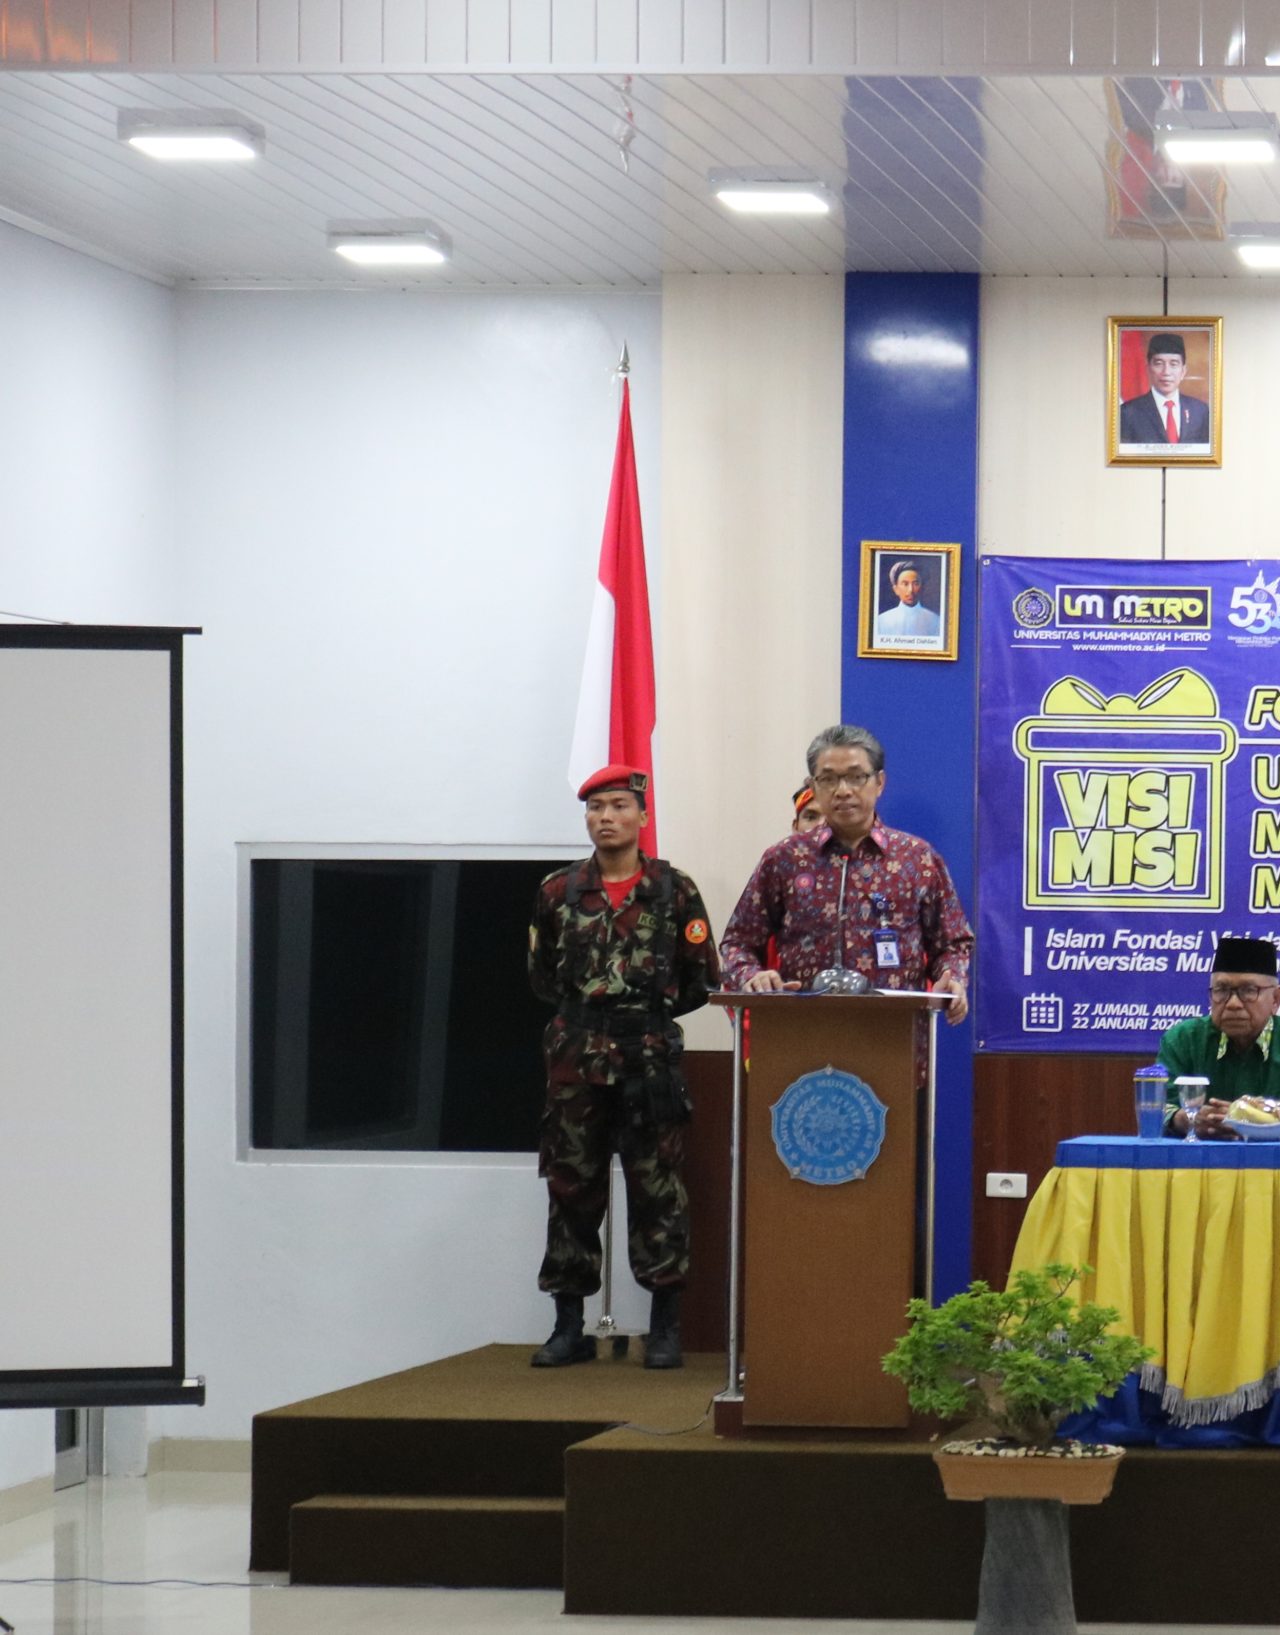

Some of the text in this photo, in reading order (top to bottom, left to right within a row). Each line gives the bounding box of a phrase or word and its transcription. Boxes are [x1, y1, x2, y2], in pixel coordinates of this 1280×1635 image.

[1113, 595, 1204, 623] METRO
[1013, 630, 1211, 642] UNIVERSITAS MUHAMMADIYAH METRO
[1072, 643, 1165, 652] www.ummetro.ac.id
[1057, 770, 1192, 830] VISI
[1051, 829, 1198, 888] MISI
[1045, 928, 1106, 949] Islam
[1112, 929, 1204, 951] Fondasi
[1046, 950, 1168, 972] Universitas
[1072, 1003, 1088, 1016] 27
[1091, 1003, 1150, 1016] JUMADIL
[1152, 1004, 1203, 1017] AWWAL
[1072, 1017, 1088, 1029] 22
[1091, 1017, 1148, 1030] JANUARI
[799, 1160, 858, 1177] METRO
